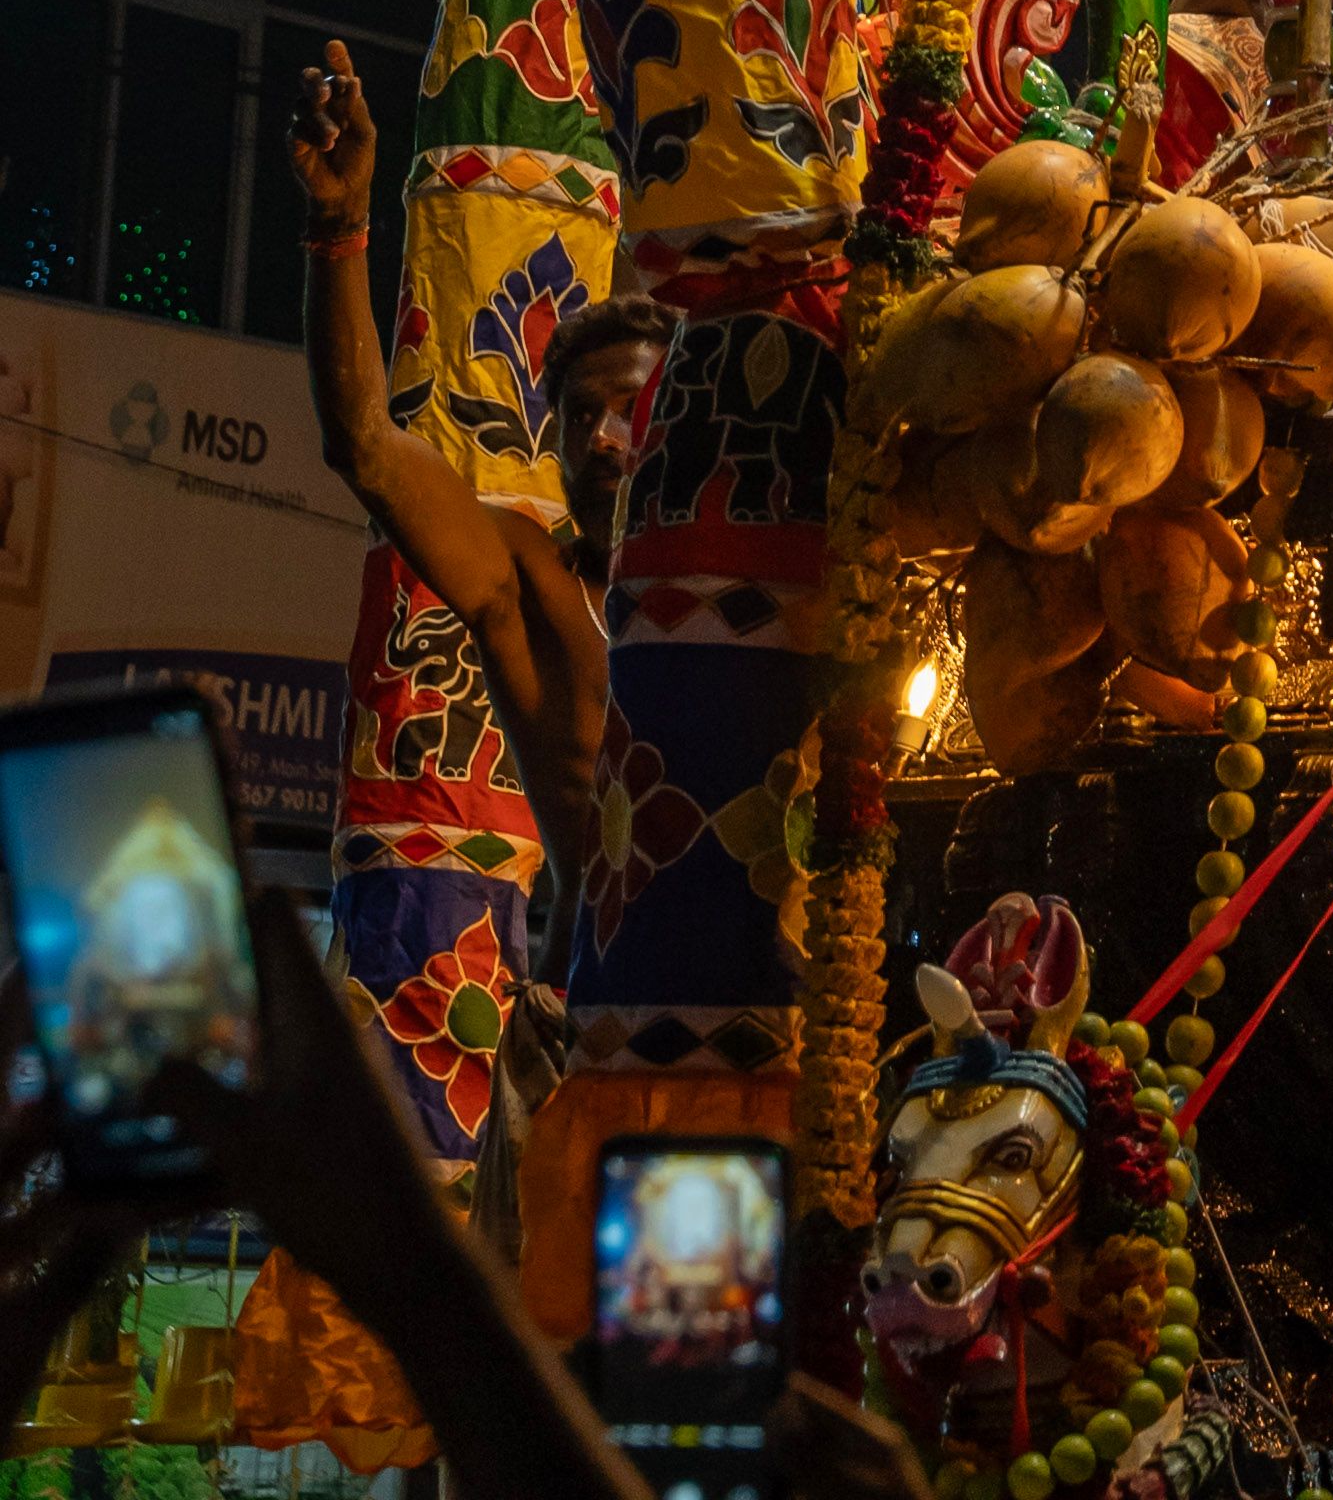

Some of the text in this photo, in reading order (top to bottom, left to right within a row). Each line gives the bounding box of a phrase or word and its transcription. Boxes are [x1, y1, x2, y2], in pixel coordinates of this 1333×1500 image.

[182, 408, 269, 466] MSD
[175, 472, 307, 510] Animal Health
[281, 787, 329, 813] 9013
